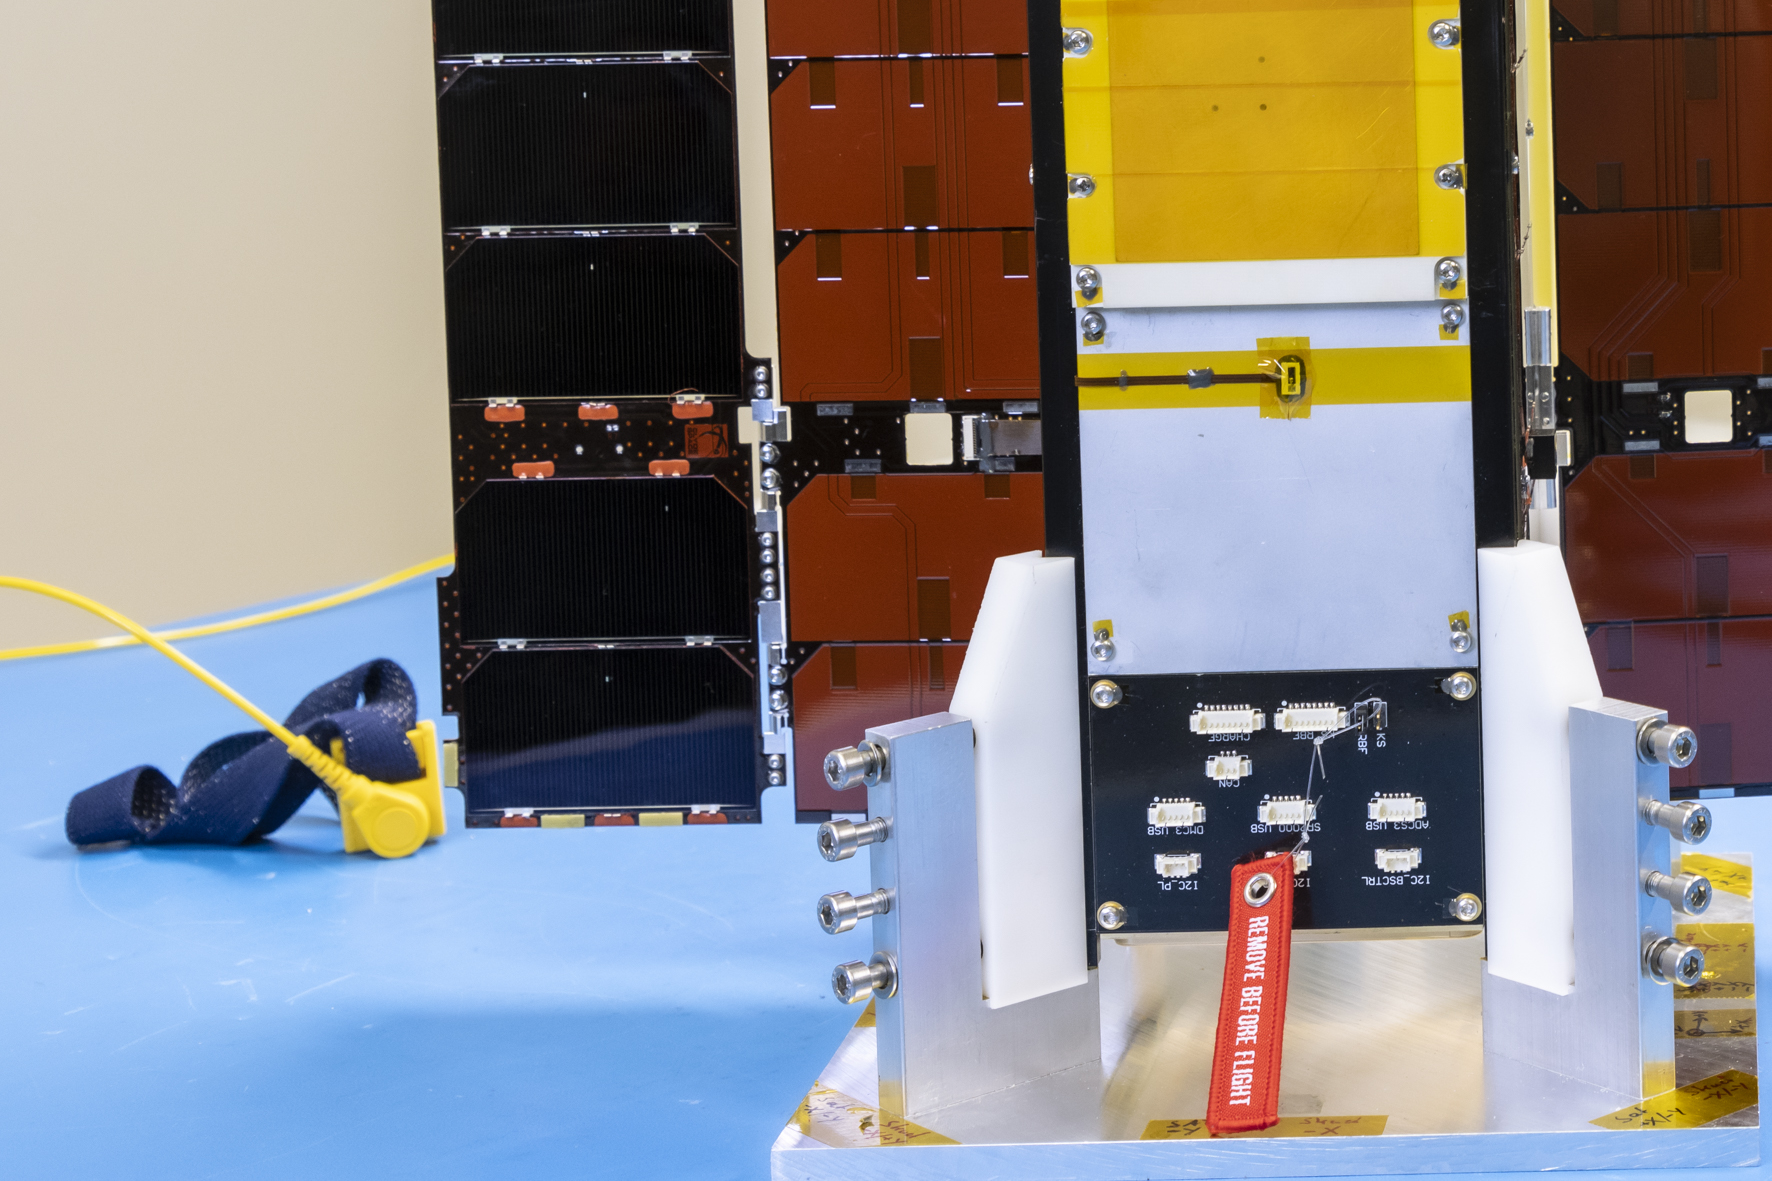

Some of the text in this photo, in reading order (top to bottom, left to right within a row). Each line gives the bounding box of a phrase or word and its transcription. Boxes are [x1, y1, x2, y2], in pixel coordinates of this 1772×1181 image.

[1208, 732, 1250, 742] CHARGE
[1292, 731, 1314, 740] RBF
[1376, 732, 1386, 748] KS
[1218, 779, 1240, 788] CAN
[1157, 880, 1198, 891] I2C_PL
[1361, 874, 1431, 886] I2C_BSCTRL
[1229, 915, 1269, 1106] REMOVE BEFORE FLIGHT
